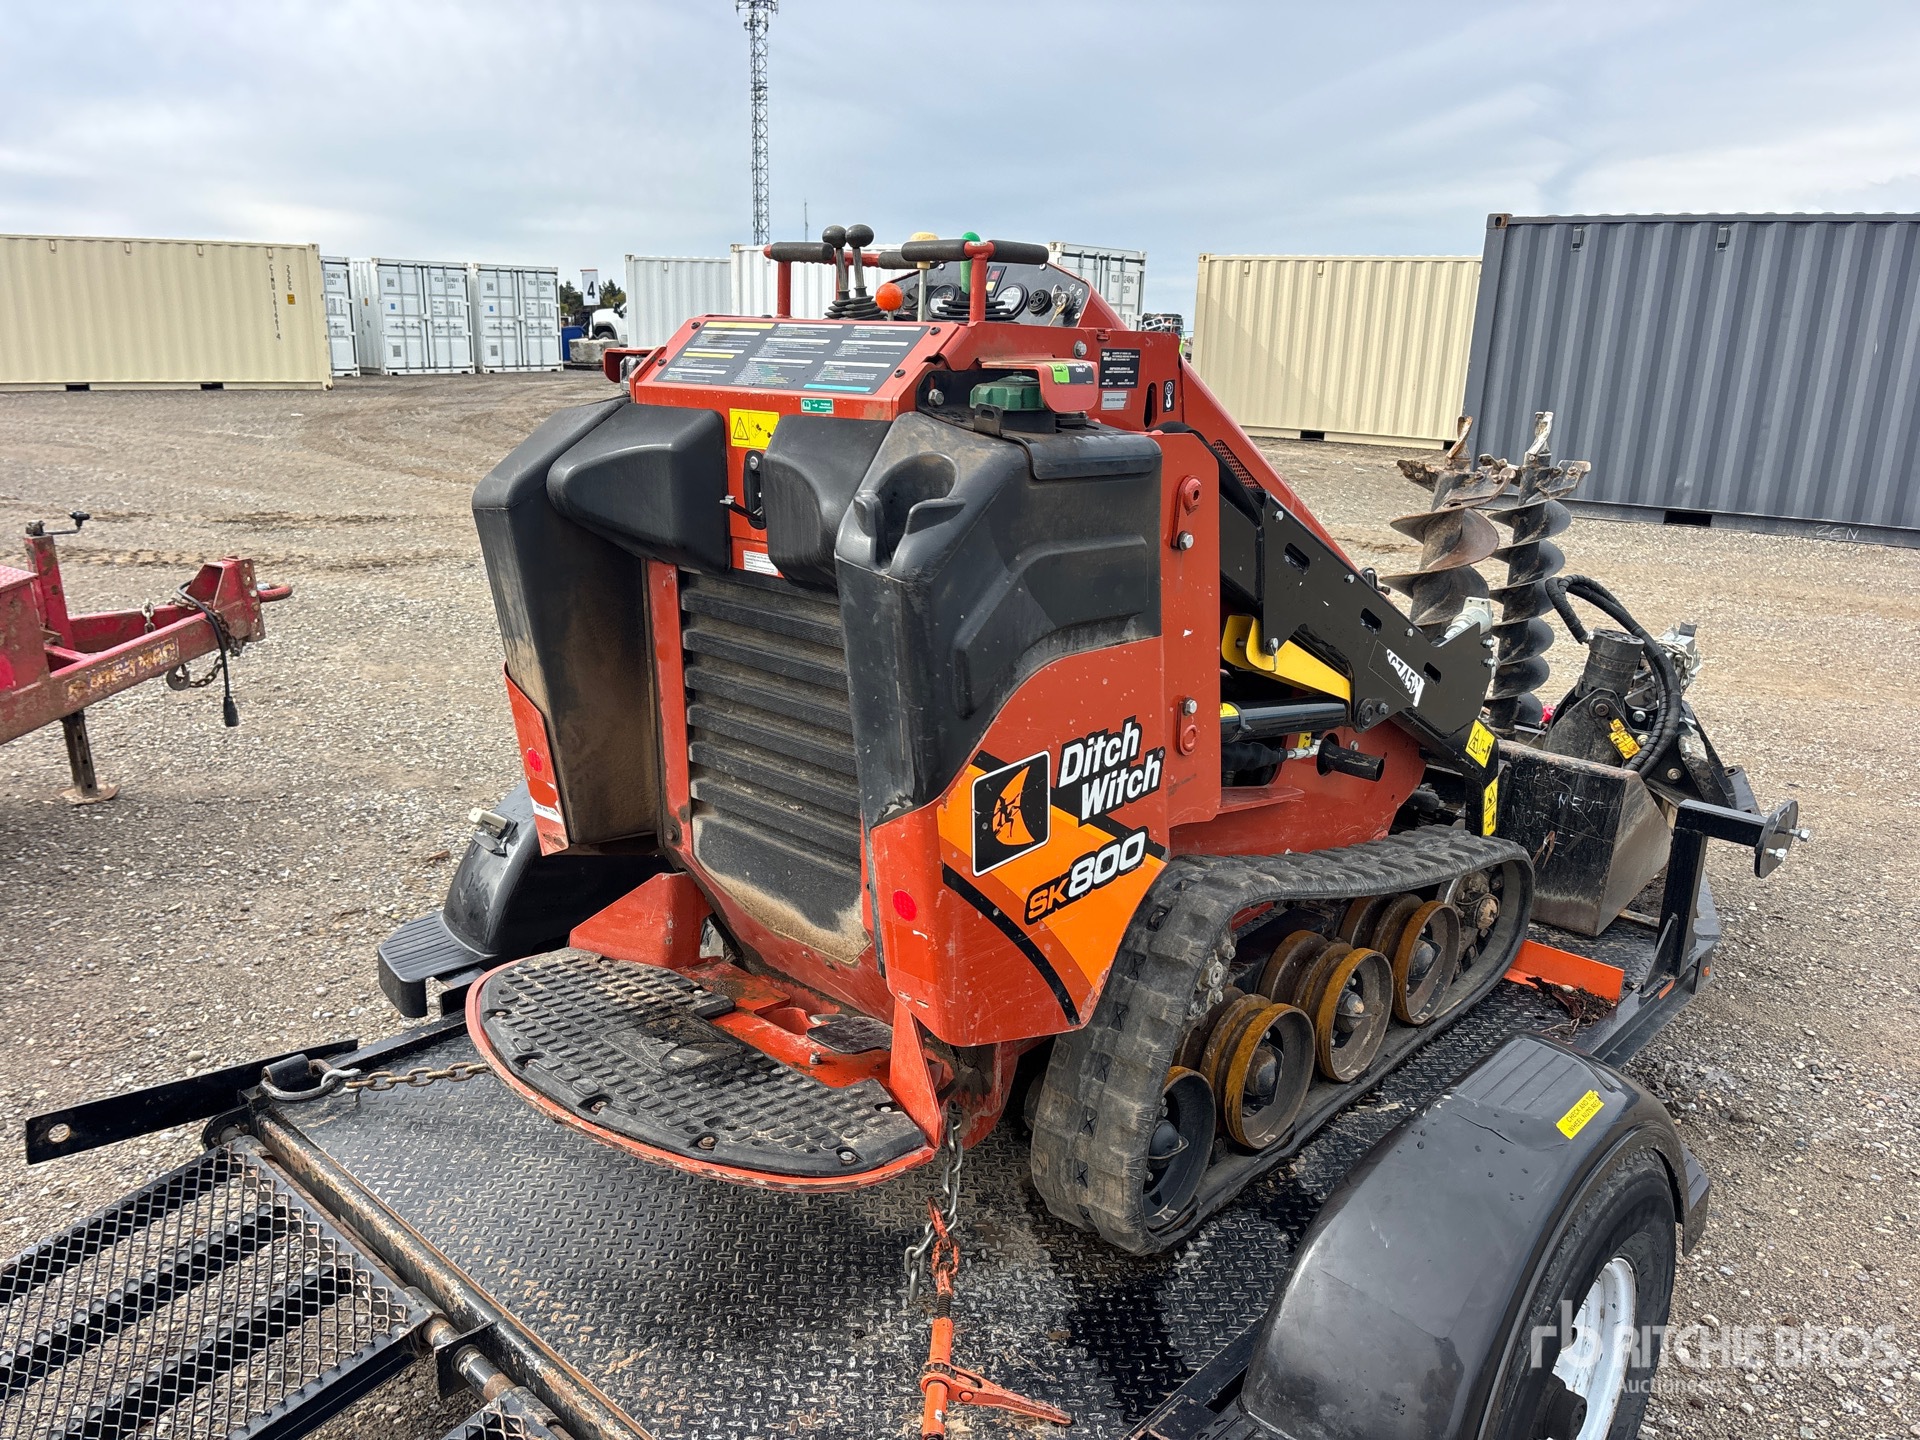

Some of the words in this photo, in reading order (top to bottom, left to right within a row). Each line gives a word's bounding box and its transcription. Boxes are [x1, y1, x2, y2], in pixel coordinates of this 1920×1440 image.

[587, 280, 596, 299] 4
[1059, 721, 1140, 788] Ditch
[1081, 754, 1161, 821] Witch
[1028, 831, 1146, 919] SK800
[1565, 1107, 1581, 1123] CHECK
[1579, 1099, 1589, 1110] AND
[1567, 1117, 1585, 1132] WHEEL
[1582, 1106, 1594, 1119] NUTS
